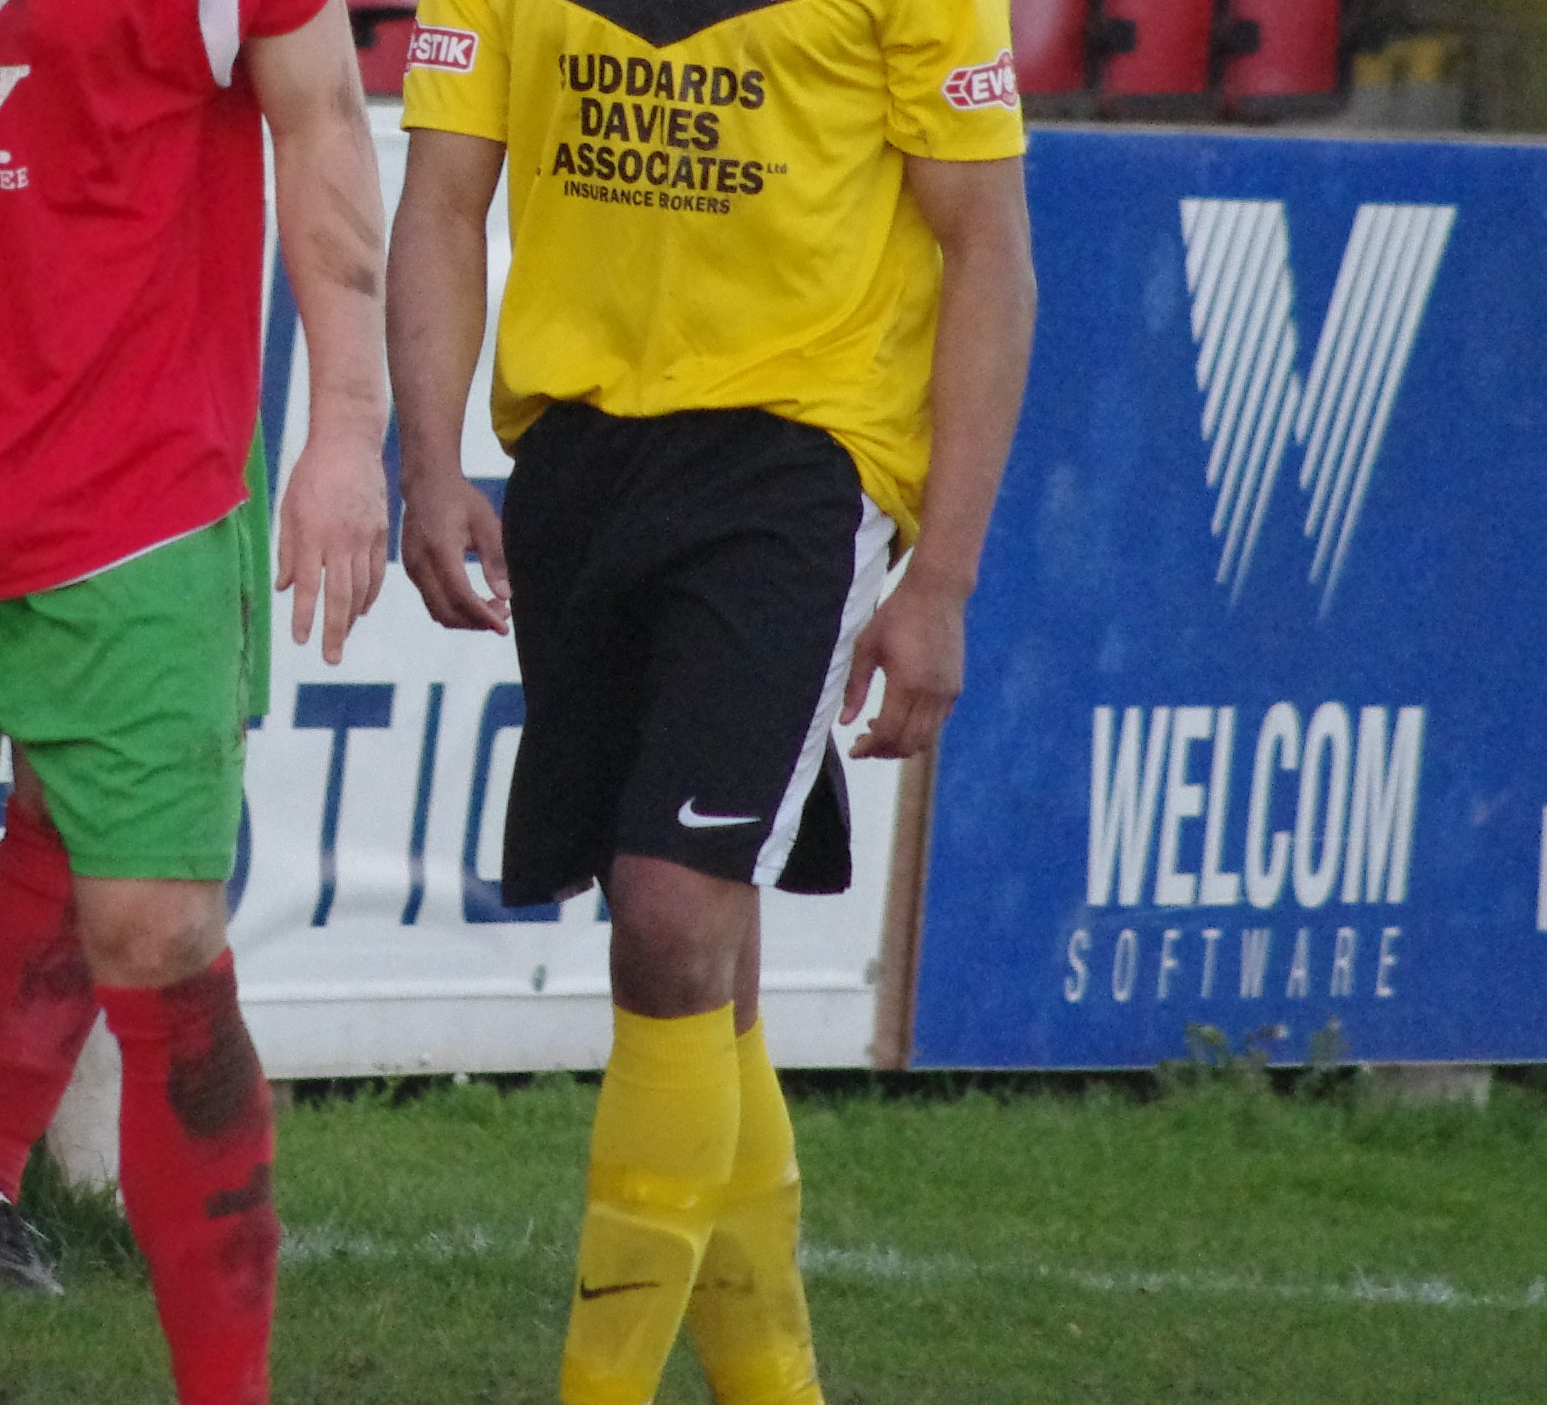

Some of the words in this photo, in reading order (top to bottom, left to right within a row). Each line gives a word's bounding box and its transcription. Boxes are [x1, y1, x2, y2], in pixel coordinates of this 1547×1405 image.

[407, 32, 473, 65] -STIK
[552, 143, 765, 195] ASSOCATES
[564, 180, 653, 207] INSURANCE
[1086, 701, 1426, 909] WELCOM
[1064, 926, 1401, 1002] SOFTWARE
